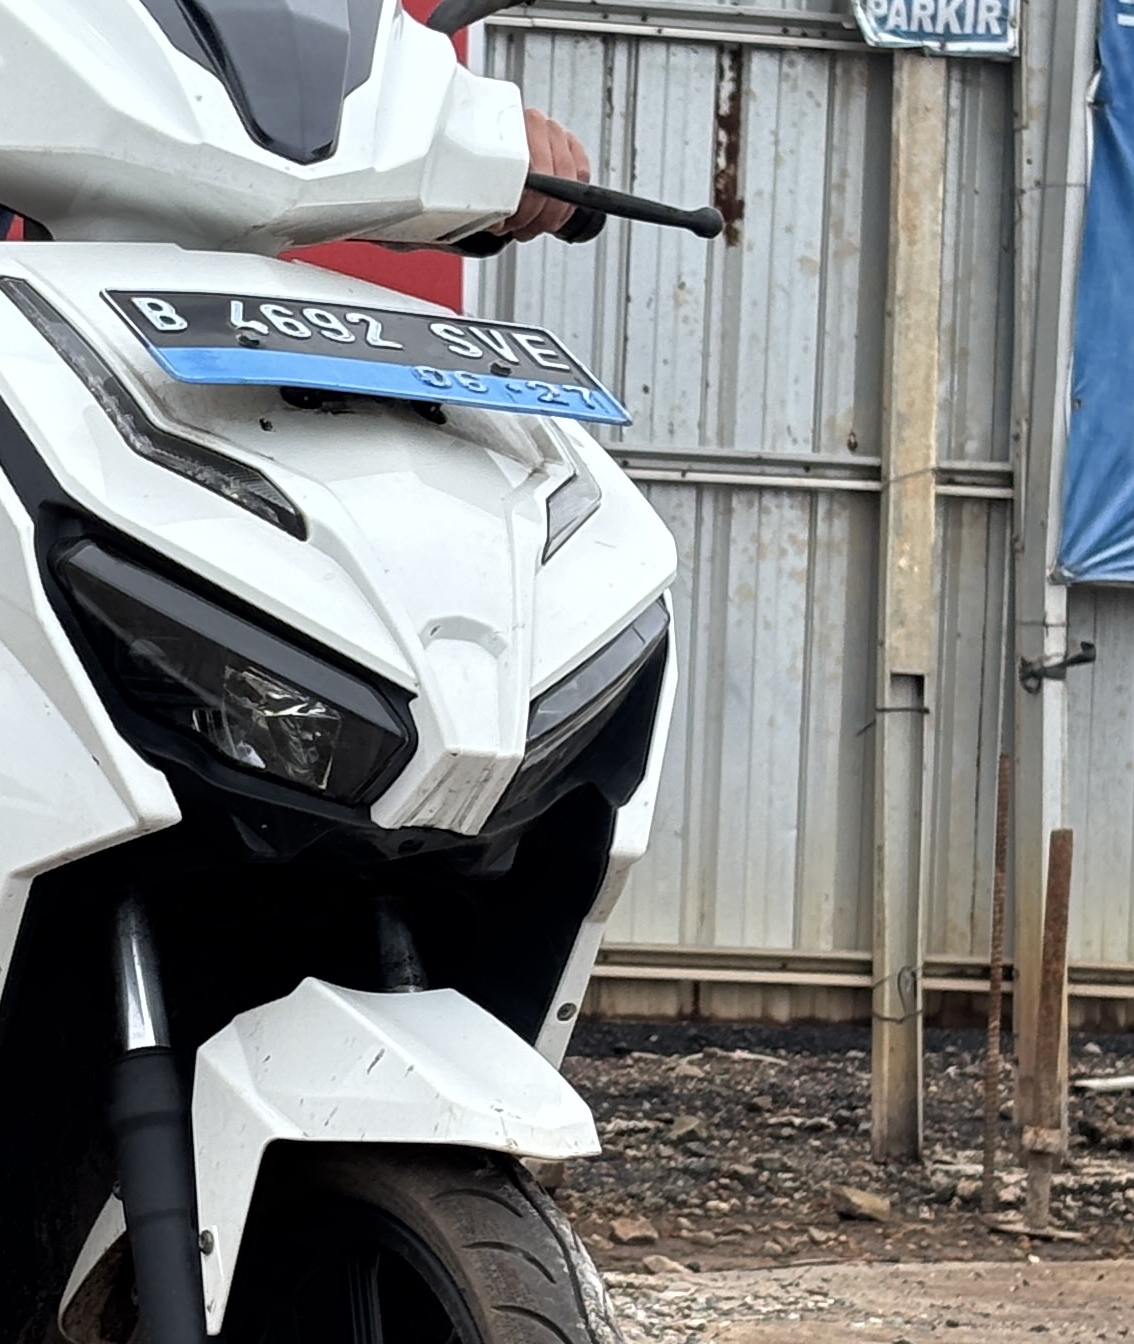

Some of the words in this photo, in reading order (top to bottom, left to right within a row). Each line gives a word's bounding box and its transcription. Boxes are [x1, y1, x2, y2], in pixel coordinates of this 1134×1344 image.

[130, 296, 189, 332] B
[229, 299, 403, 350] 4692
[429, 321, 571, 371] SVE
